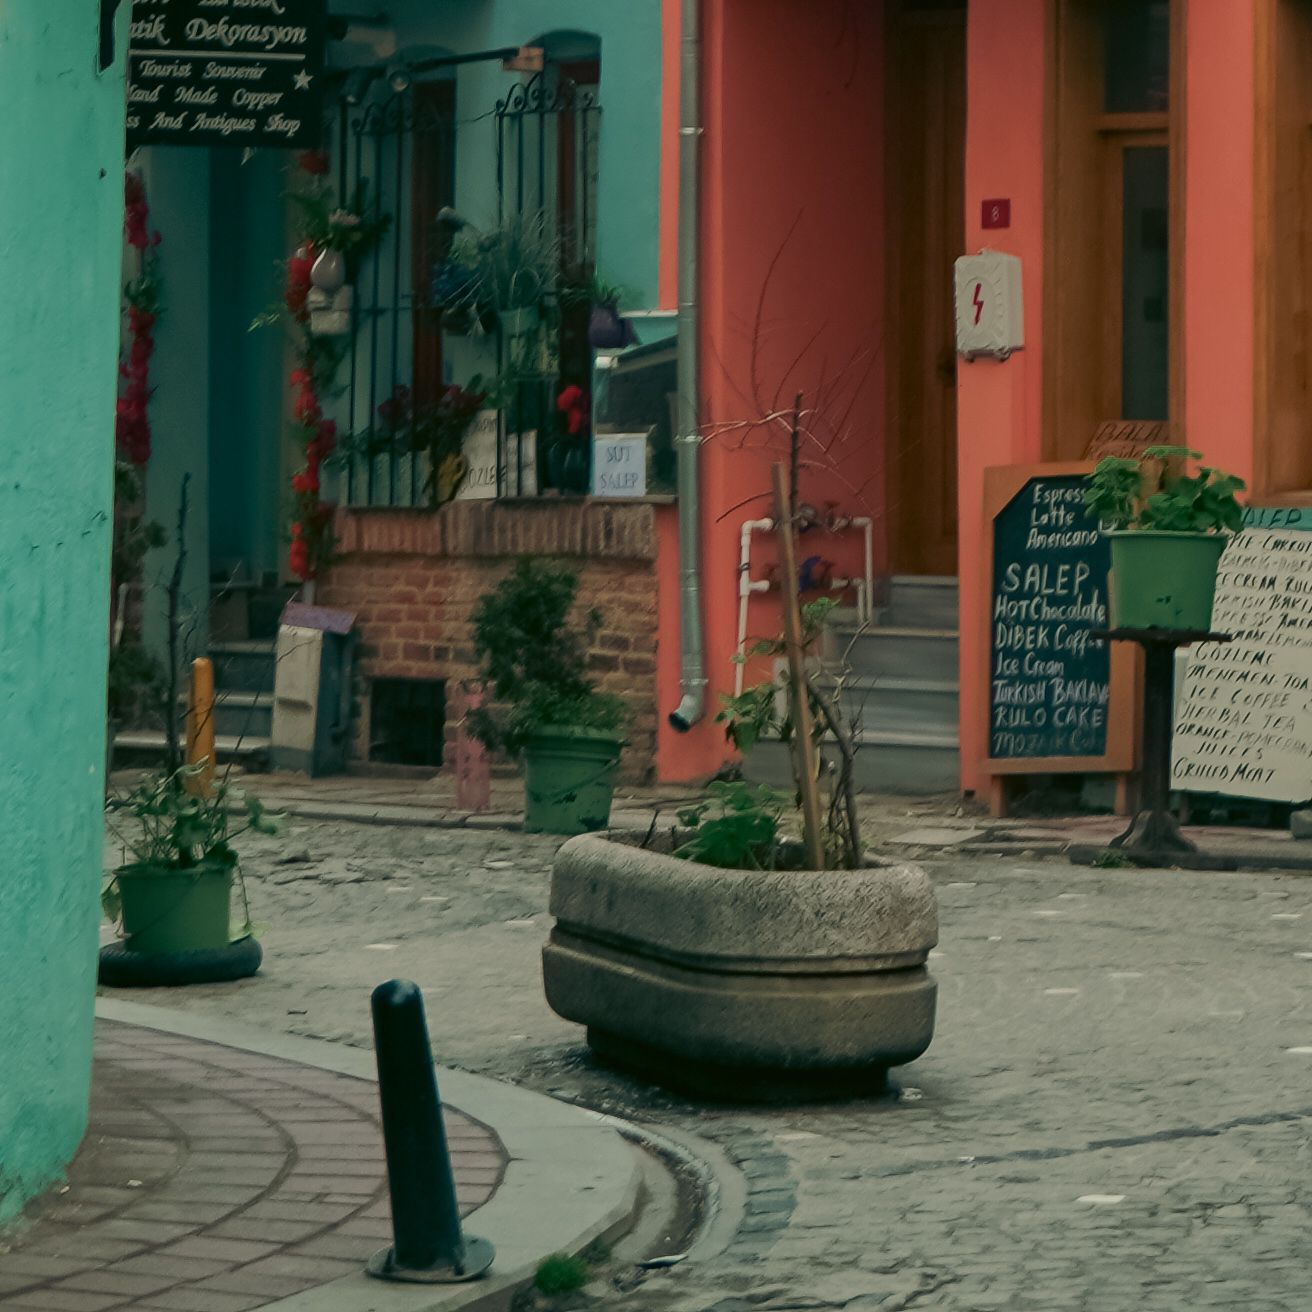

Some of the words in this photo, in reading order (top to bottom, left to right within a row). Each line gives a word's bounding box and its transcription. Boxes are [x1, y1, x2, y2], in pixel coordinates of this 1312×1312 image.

[185, 16, 307, 50] Dekorasyon
[139, 59, 193, 77] Tourist
[202, 62, 267, 80] Souvenir
[174, 86, 218, 104] Made
[232, 88, 284, 110] Copper
[149, 111, 188, 130] And
[263, 113, 301, 137] Shop
[1026, 527, 1098, 549] Americano
[1001, 562, 1090, 595] SALEP
[996, 651, 1020, 676] Ice
[1023, 651, 1064, 676] Cream
[1190, 684, 1219, 700] ICE
[994, 705, 1047, 728] RULO
[1052, 705, 1103, 728] CAKE
[1263, 712, 1296, 733] TEA
